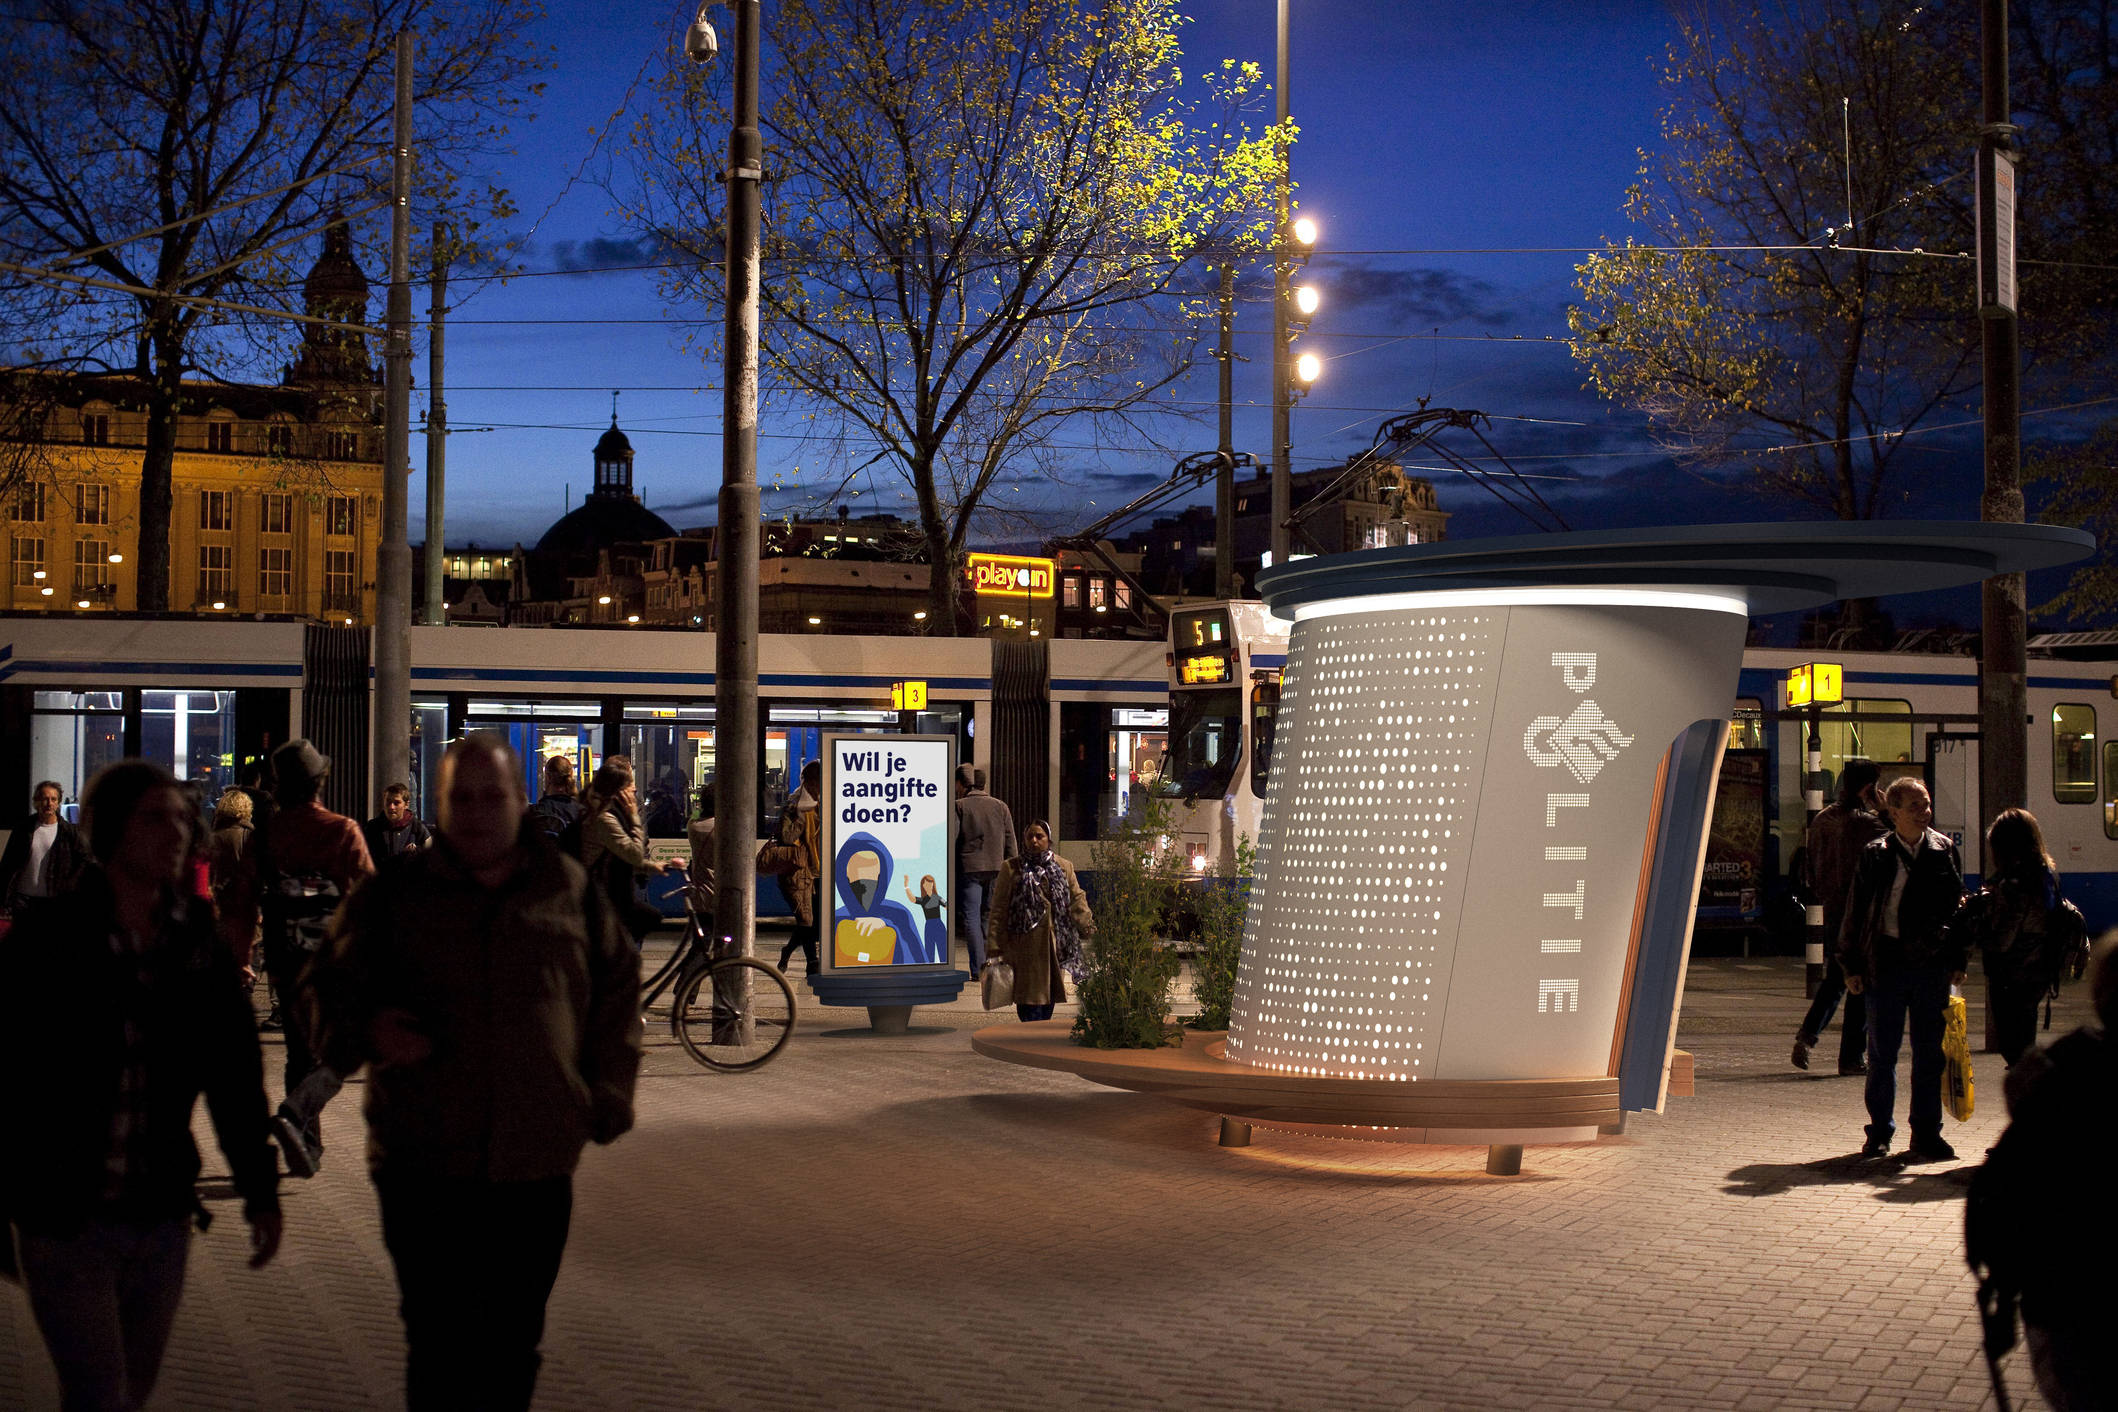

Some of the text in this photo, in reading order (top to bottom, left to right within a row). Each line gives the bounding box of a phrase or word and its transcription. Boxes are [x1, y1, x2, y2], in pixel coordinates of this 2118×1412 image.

[1825, 673, 1830, 690] 1
[912, 689, 919, 703] 3
[1733, 711, 1761, 719] CDecaux
[842, 751, 907, 777] Wil je
[842, 777, 938, 803] aangifte
[842, 803, 912, 823] doen?
[1741, 860, 1752, 880] 3
